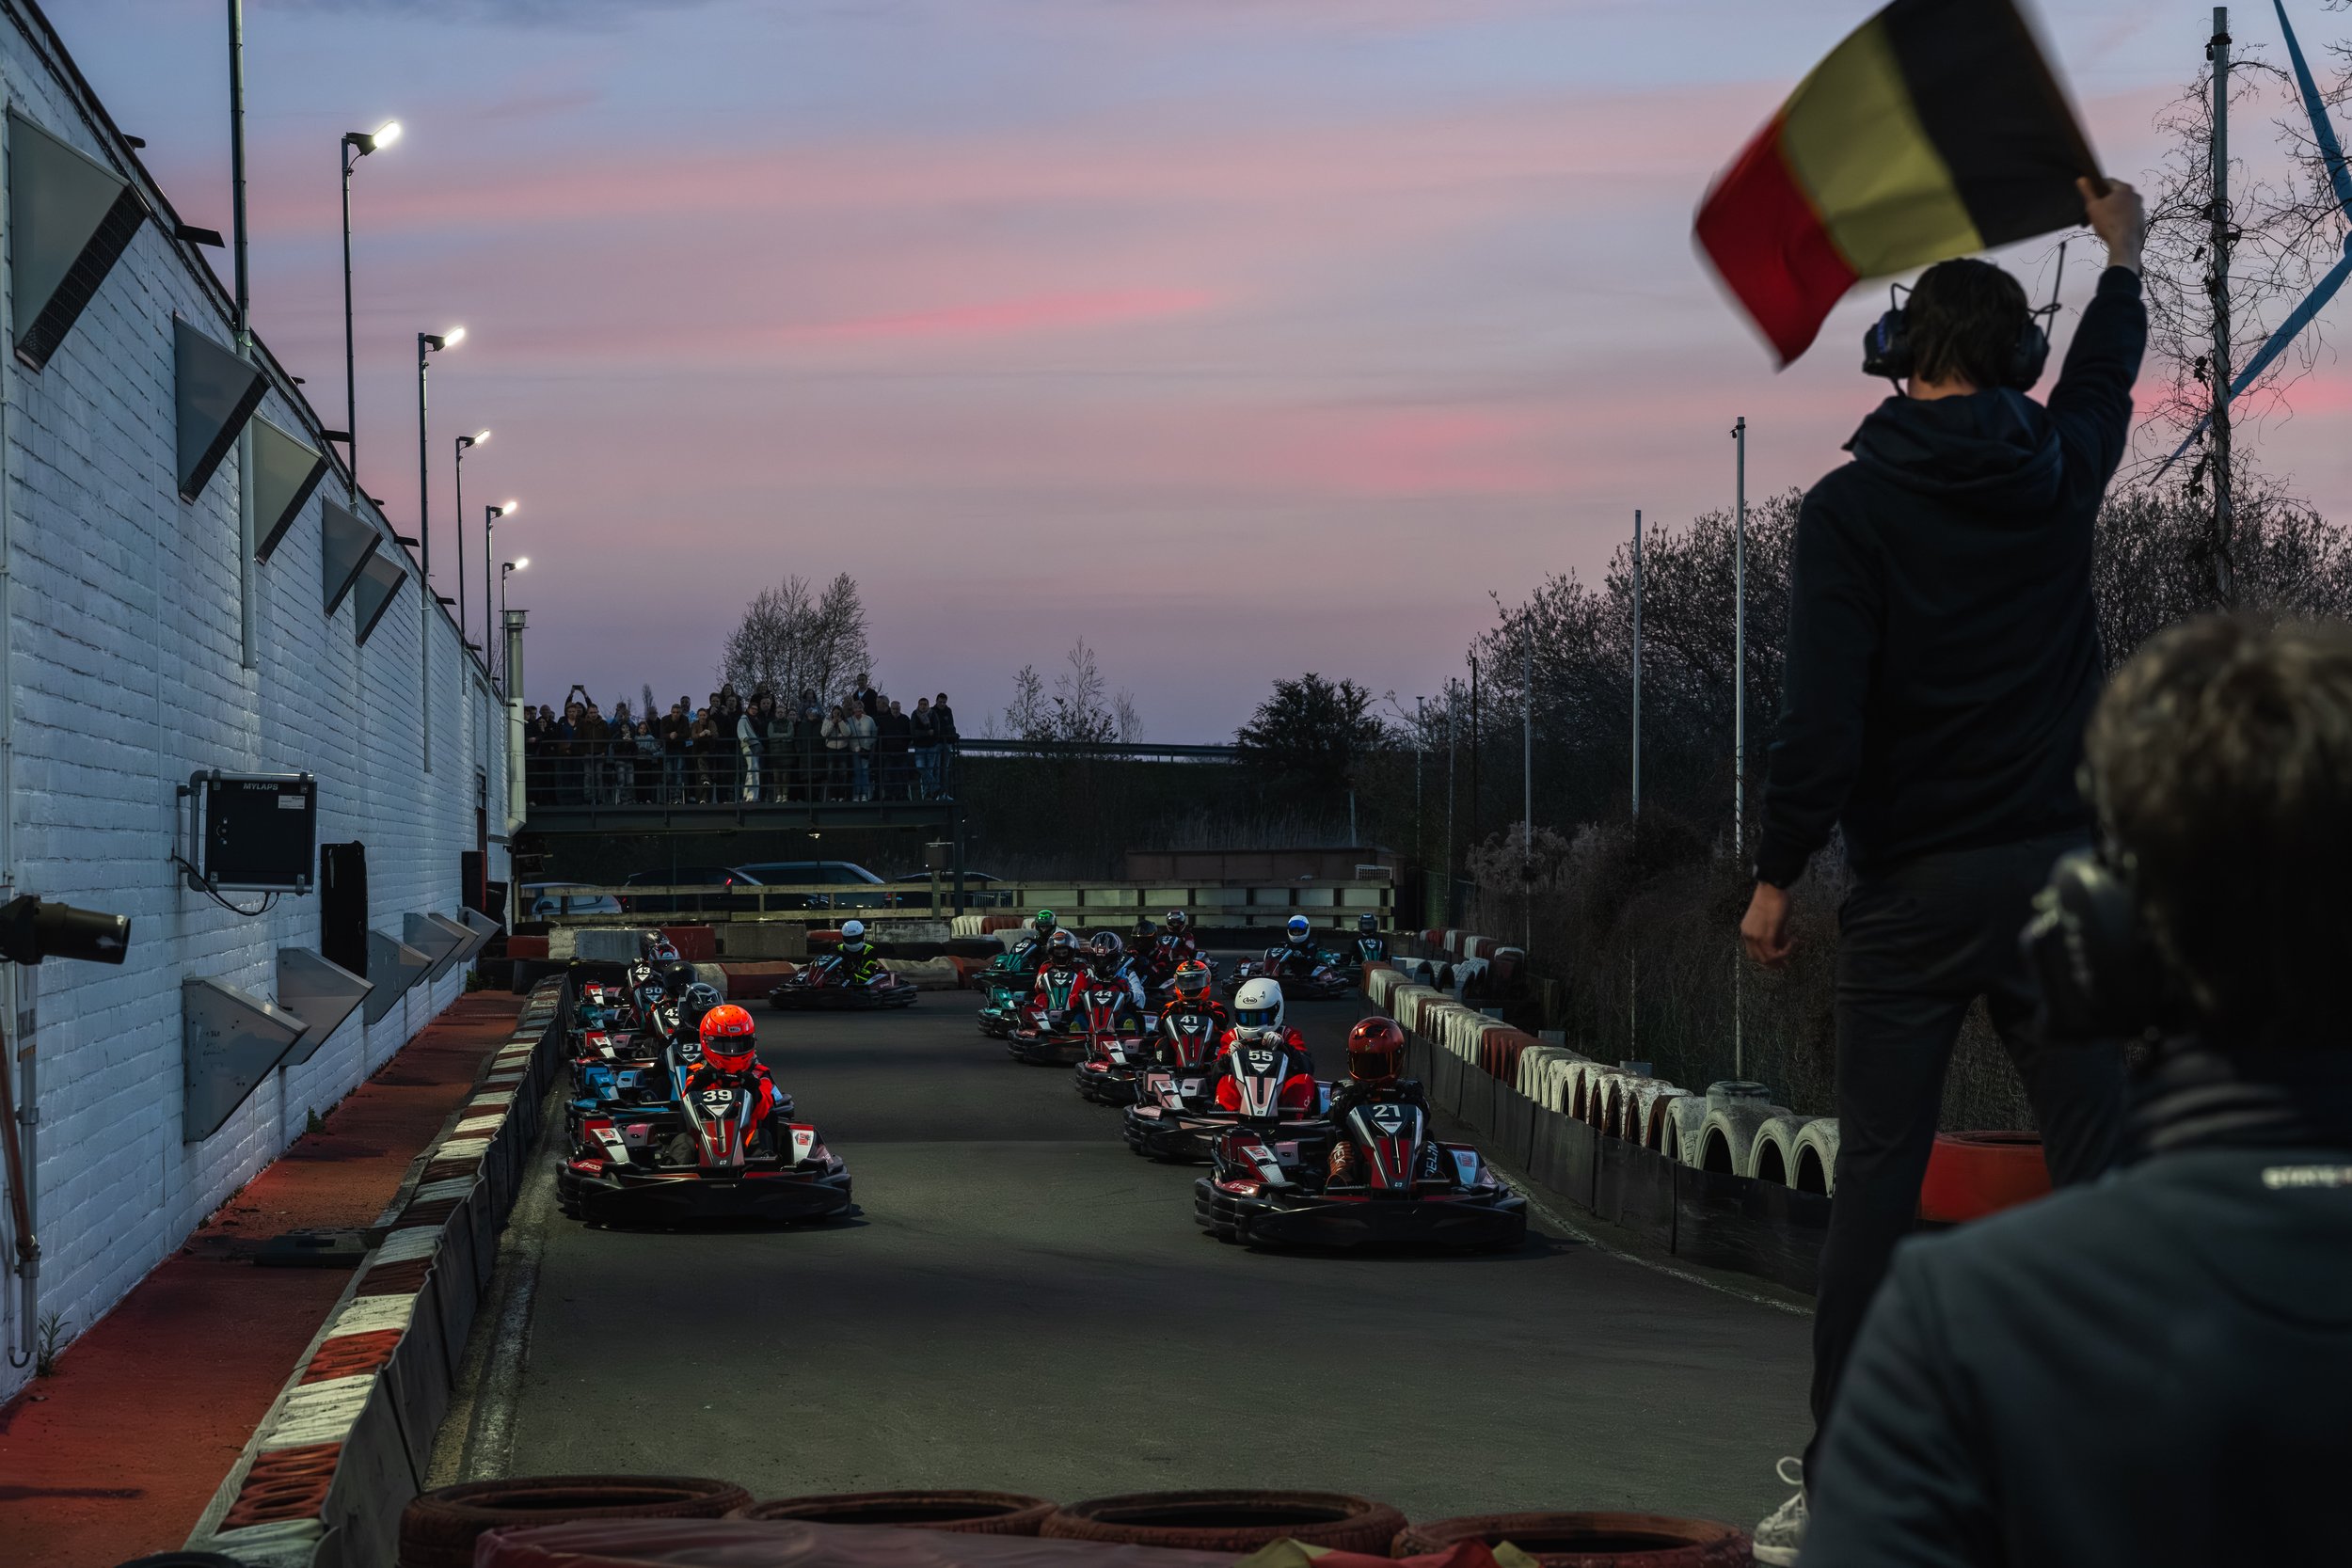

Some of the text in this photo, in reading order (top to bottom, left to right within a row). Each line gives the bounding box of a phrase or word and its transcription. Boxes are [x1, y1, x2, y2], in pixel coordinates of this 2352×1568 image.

[242, 782, 279, 790] MYLAPS
[1180, 1015, 1198, 1024] 41
[682, 1043, 702, 1052] 51
[1248, 1050, 1274, 1062] 55
[702, 1089, 733, 1102] 39
[1373, 1104, 1401, 1117] 21
